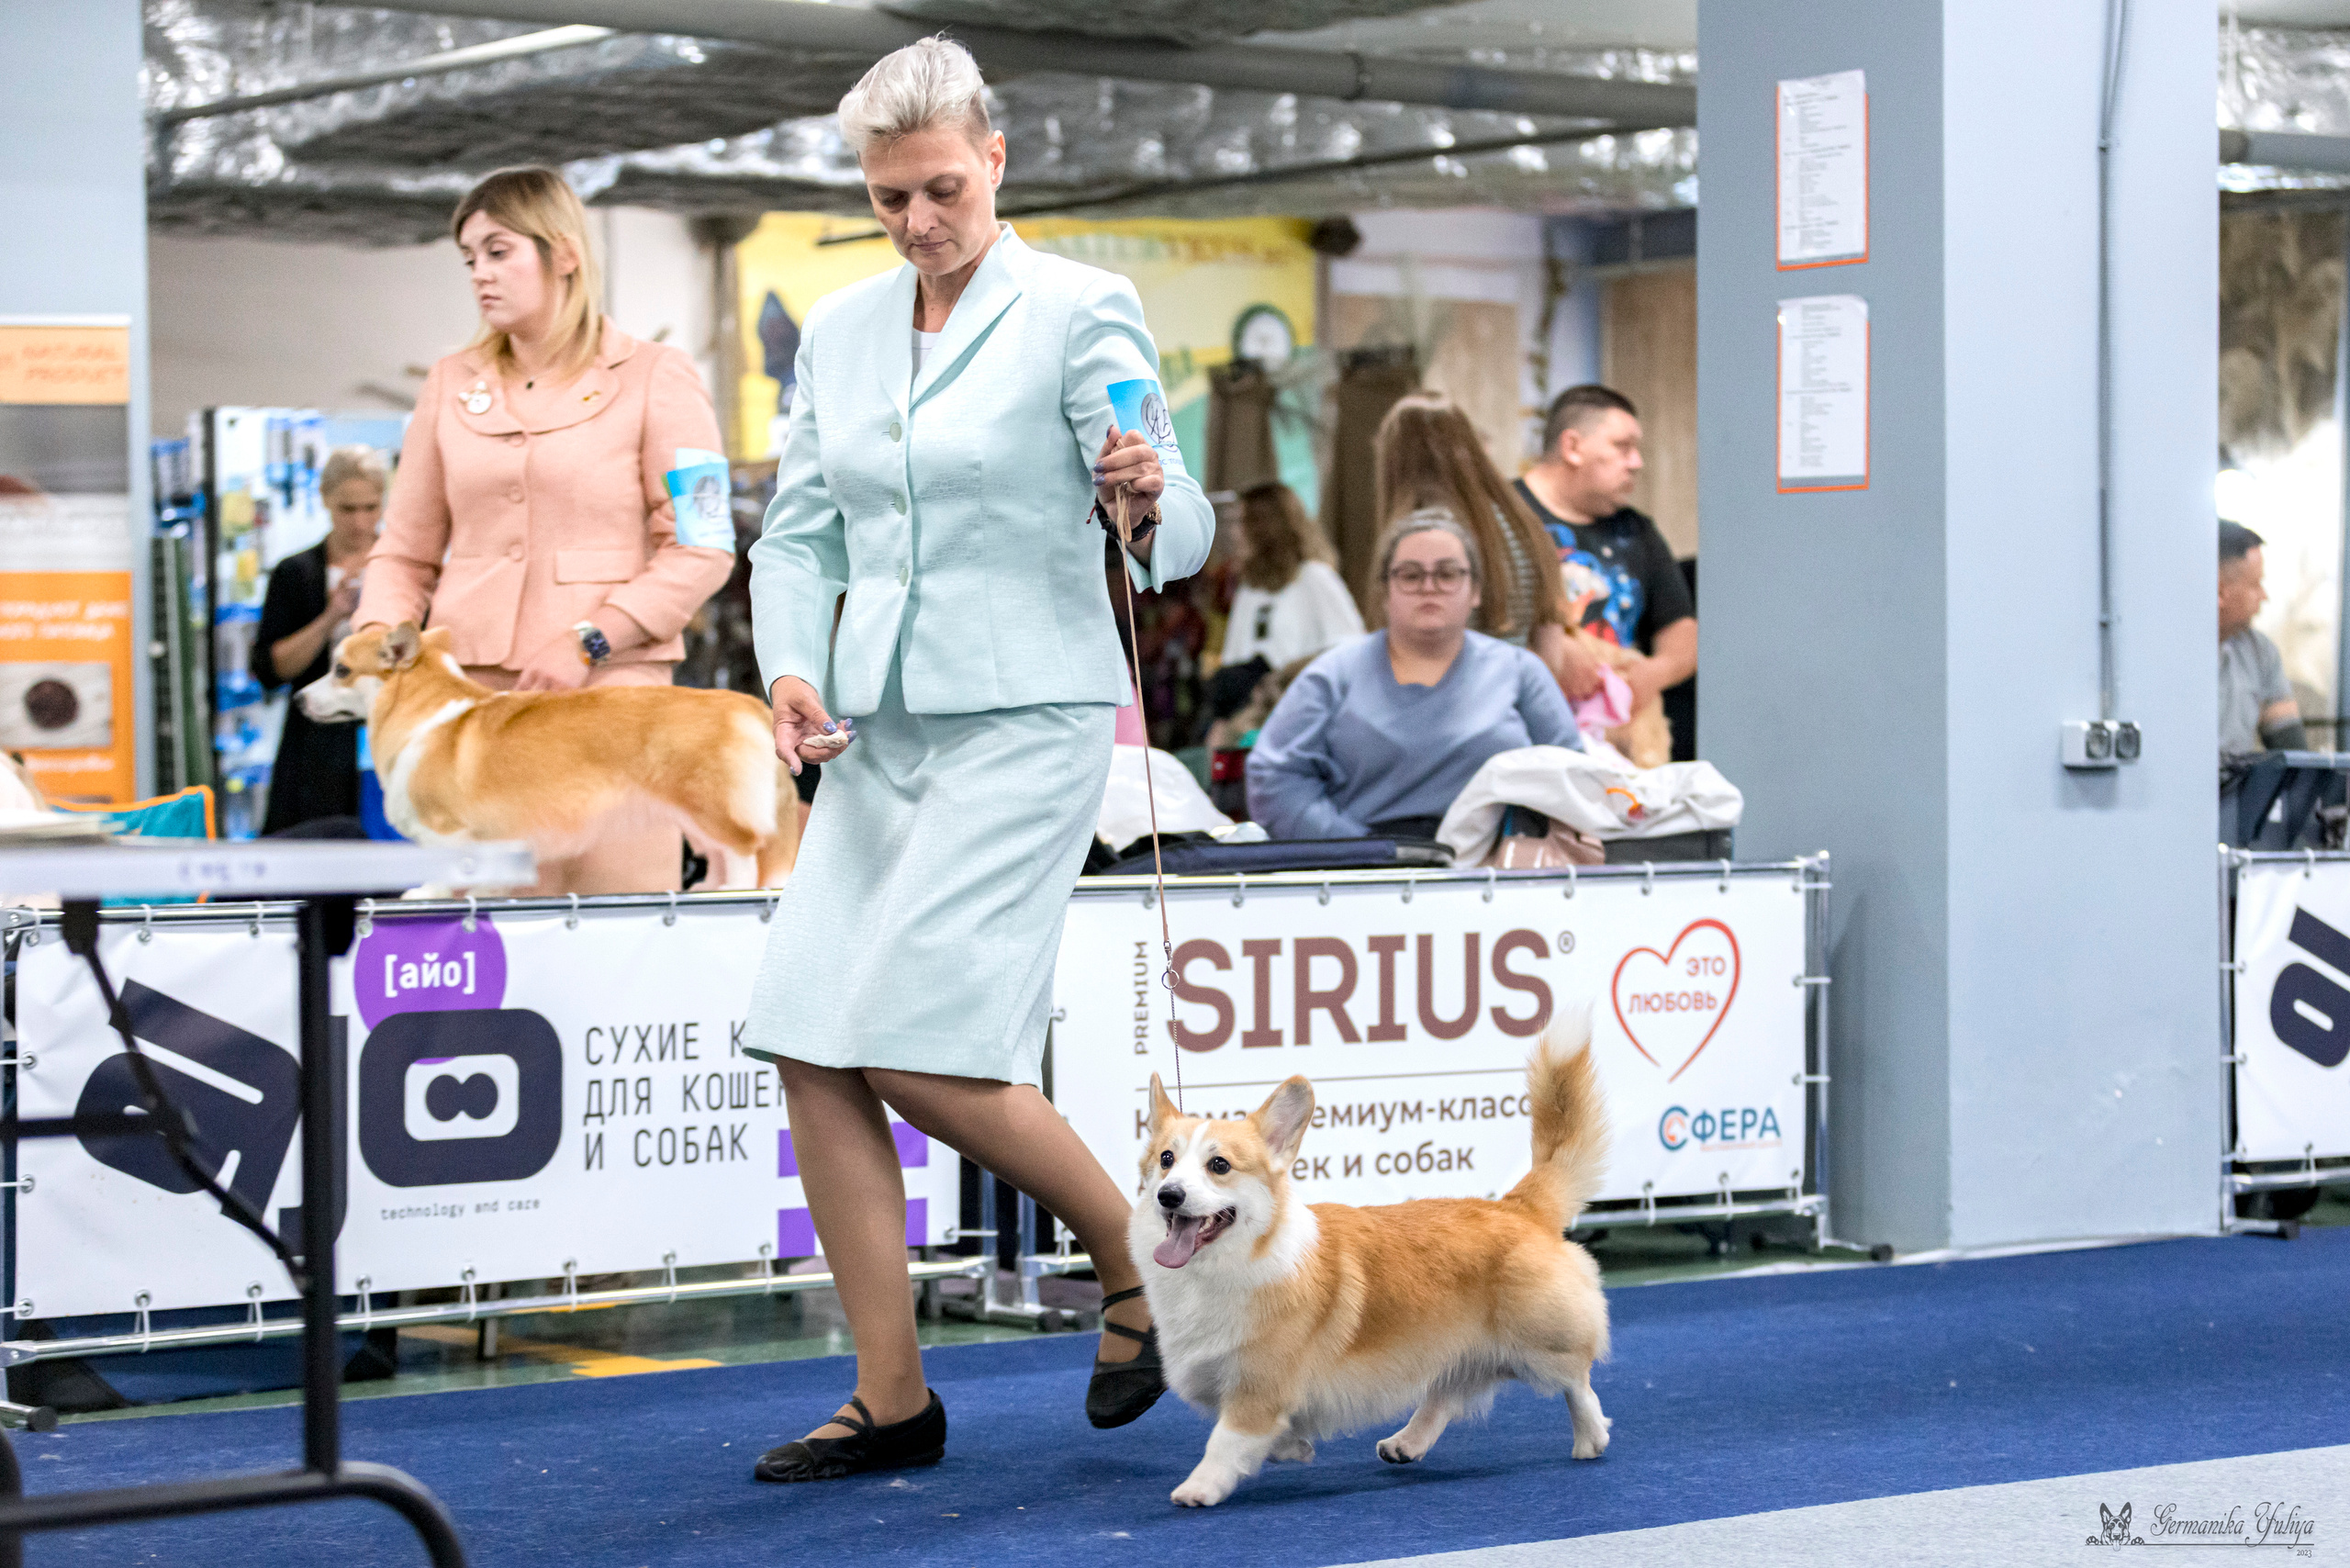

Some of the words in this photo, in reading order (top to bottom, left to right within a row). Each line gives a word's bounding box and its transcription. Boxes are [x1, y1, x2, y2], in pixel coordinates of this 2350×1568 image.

[385, 951, 476, 998] [айо]
[1685, 956, 1726, 977] ЭТО
[1134, 941, 1148, 1055] PREMIUM
[1167, 929, 1553, 1053] SIRIUS
[1628, 991, 1718, 1014] ЛЮБОВЬ
[585, 1022, 699, 1066] СУХИЕ
[583, 1076, 652, 1126] ДЛЯ
[1310, 1093, 1531, 1133] емиум-класс
[585, 1131, 603, 1170] И
[634, 1123, 748, 1167] СОБАК
[1659, 1105, 1782, 1152] СФЕРА
[1343, 1154, 1362, 1178] и
[1375, 1140, 1475, 1175] собак
[380, 1203, 465, 1220] technology
[475, 1198, 498, 1214] and
[507, 1198, 540, 1211] care
